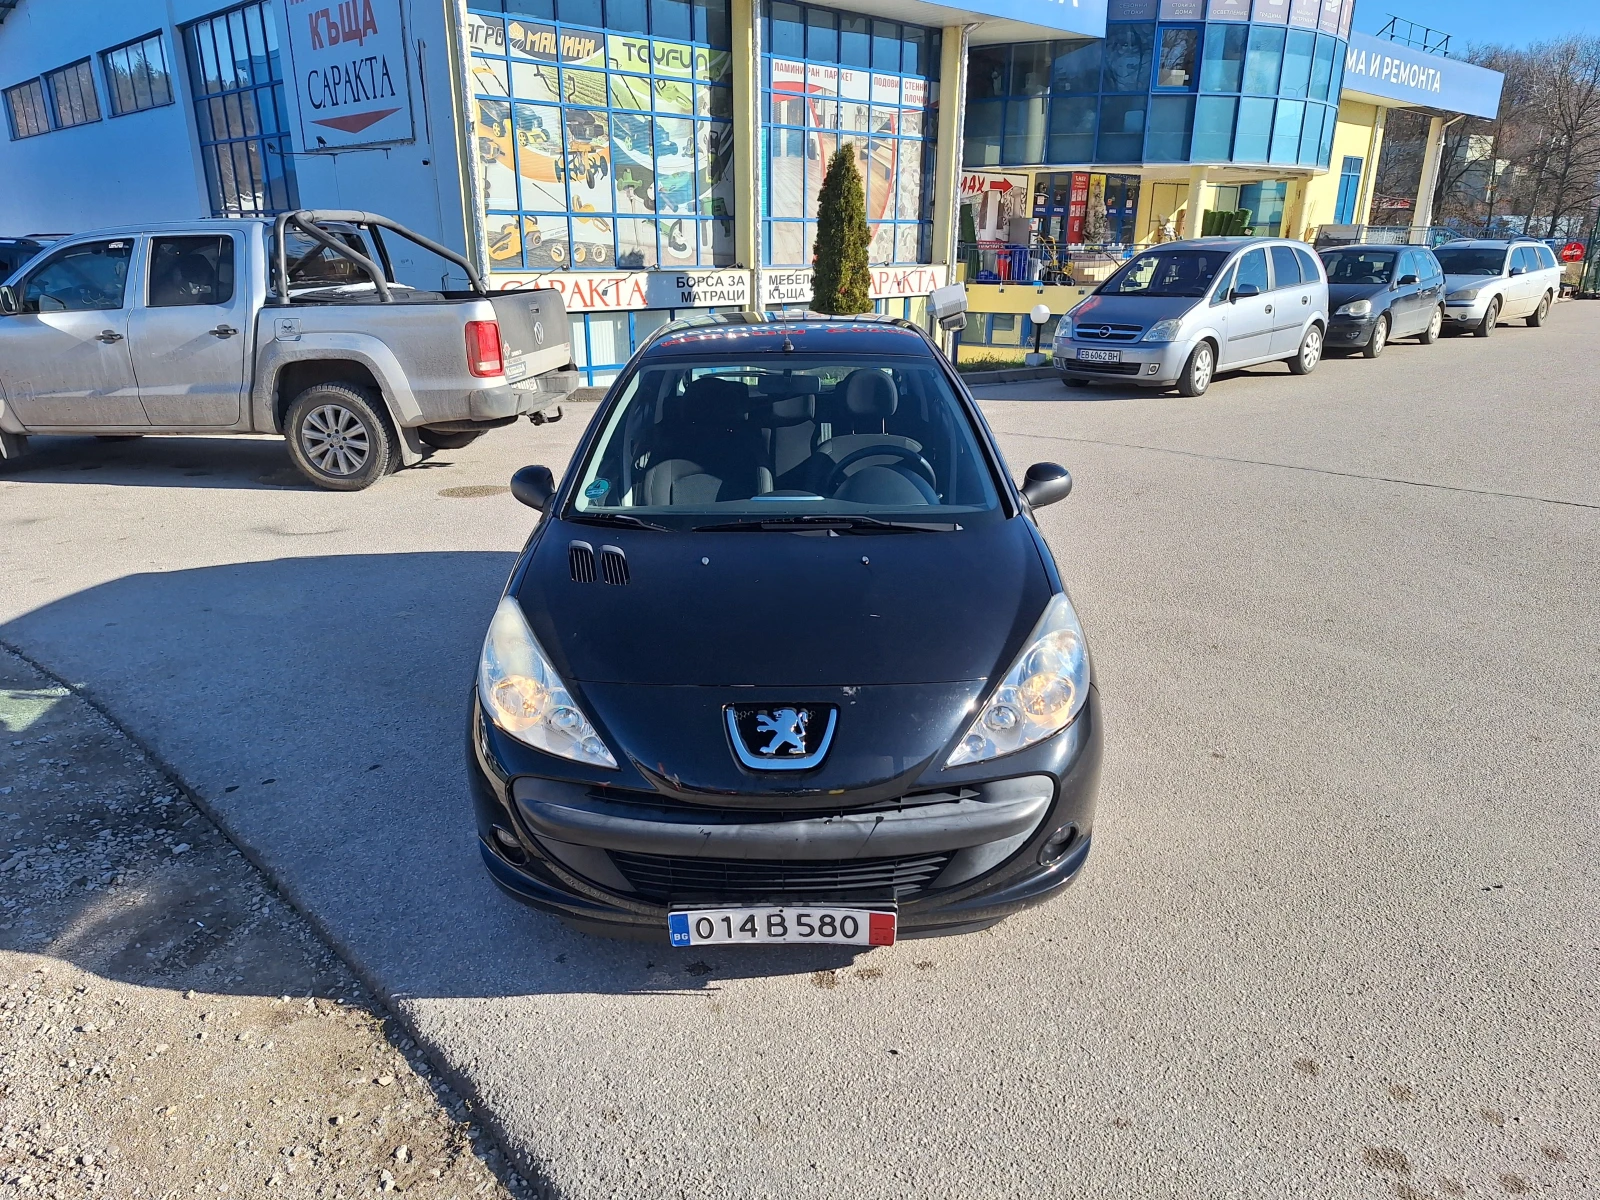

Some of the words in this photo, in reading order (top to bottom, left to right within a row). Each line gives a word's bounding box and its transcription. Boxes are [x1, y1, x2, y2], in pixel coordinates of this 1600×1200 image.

[308, 0, 378, 51] КЪЩА
[468, 23, 505, 46] АГРО
[526, 30, 596, 58] МАШИНИ
[307, 54, 396, 109] САРАКТА
[774, 62, 820, 77] ЛАМИНИРАН
[824, 69, 853, 82] ПАРКЕТ
[1369, 53, 1381, 78] И
[1382, 56, 1441, 93] РЕМОНТА
[874, 76, 899, 88] ПОДОВИ
[904, 81, 928, 92] СТЕННИ
[676, 276, 724, 288] БОРСА
[730, 275, 745, 286] ЗА
[870, 270, 938, 294] АРАКТА
[681, 289, 745, 303] МАТРАЦИ
[769, 288, 805, 300] КЪЩА
[673, 932, 689, 941] BG
